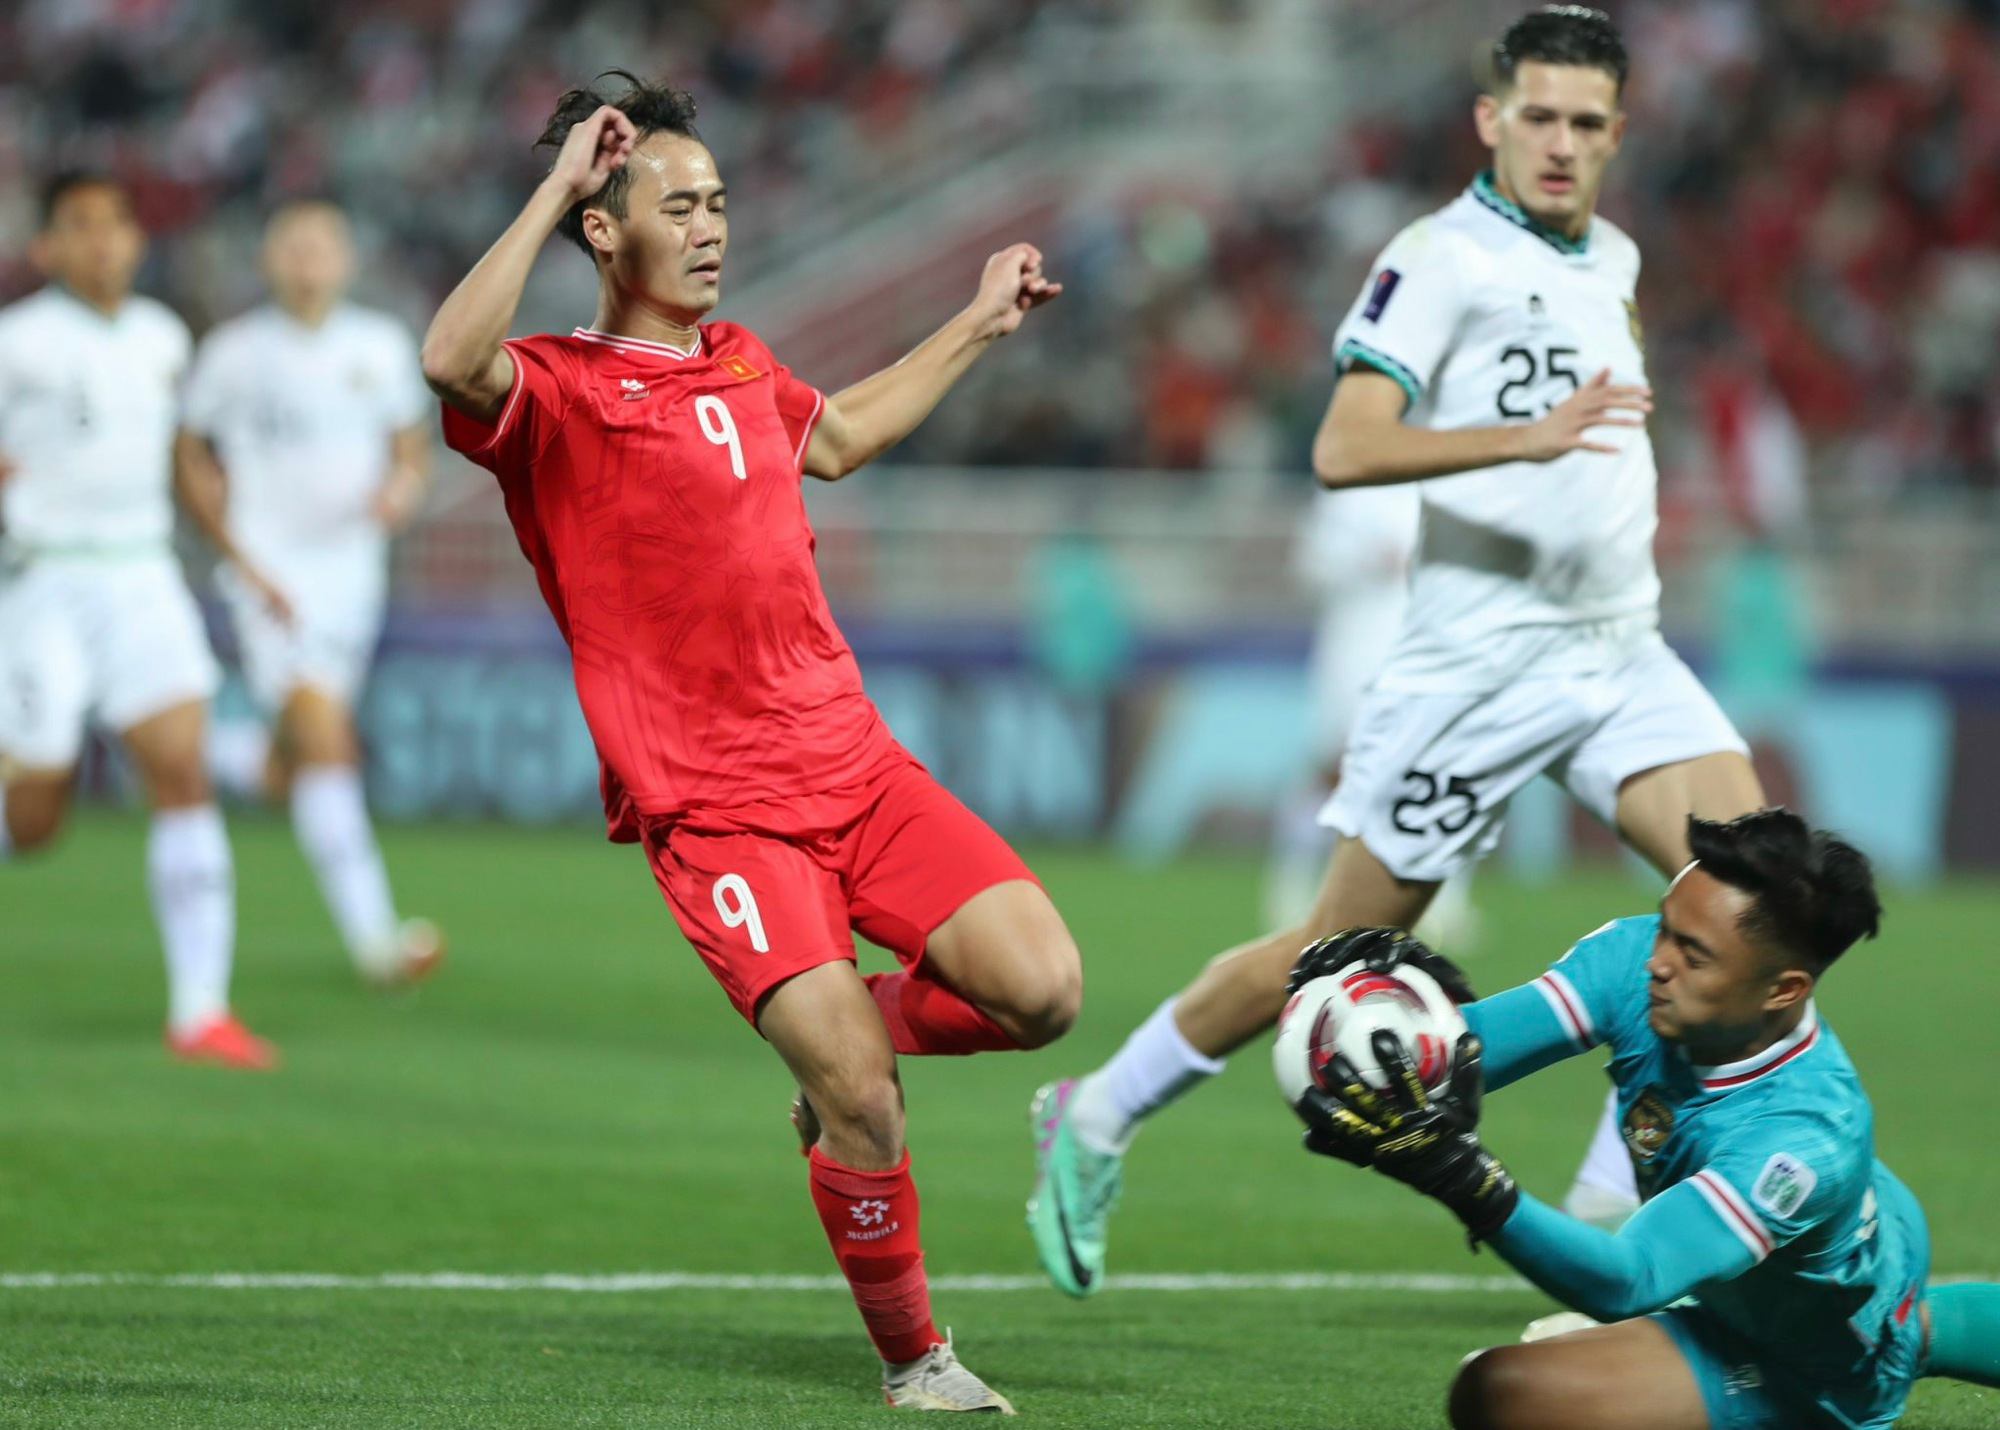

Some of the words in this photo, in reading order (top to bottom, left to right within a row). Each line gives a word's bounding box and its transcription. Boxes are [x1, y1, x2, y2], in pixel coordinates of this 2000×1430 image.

[1496, 346, 1579, 418] 25
[694, 394, 747, 480] 9
[1391, 769, 1479, 834] 25
[712, 872, 770, 954] 9
